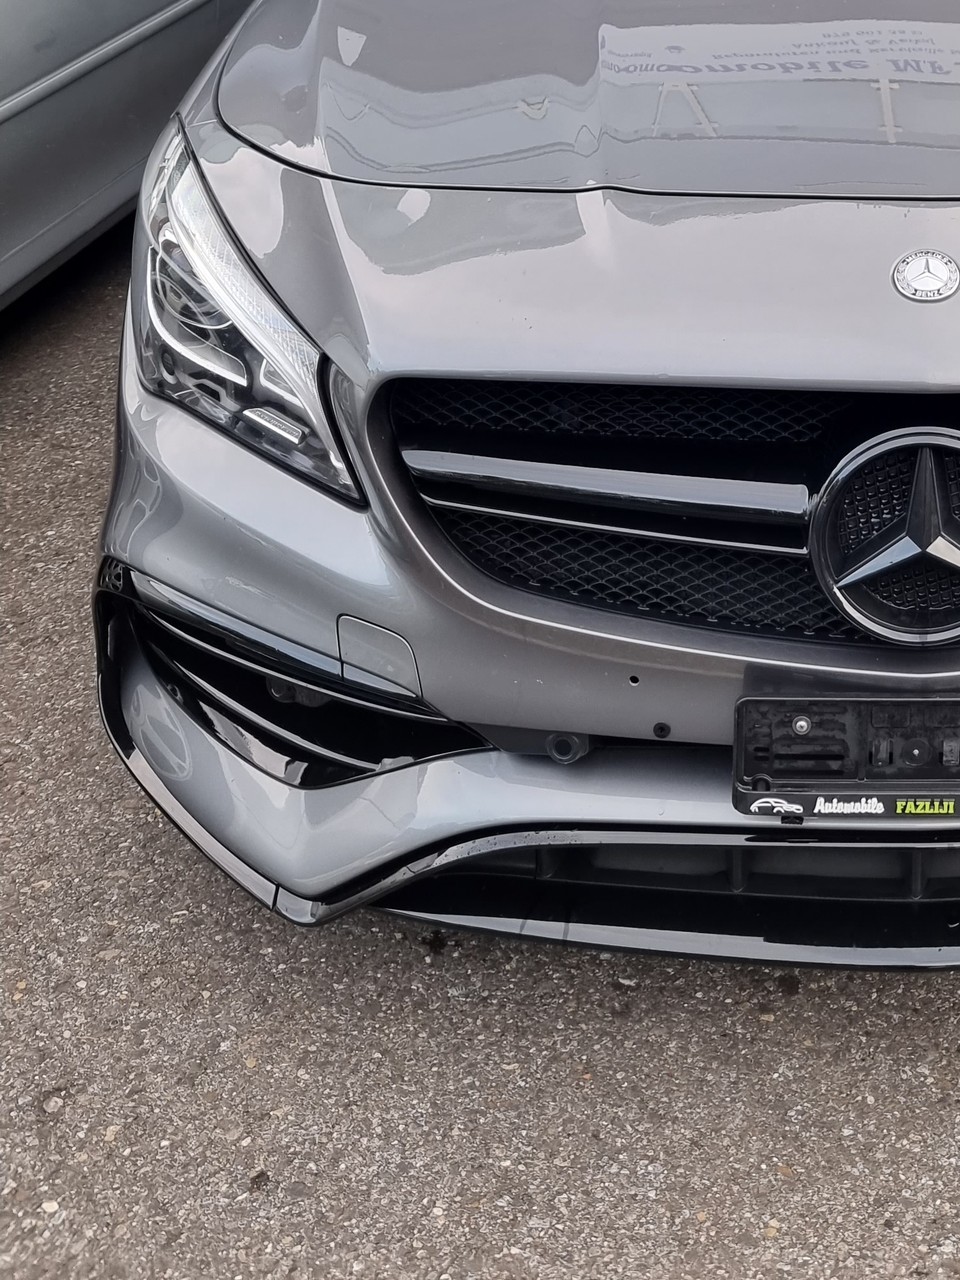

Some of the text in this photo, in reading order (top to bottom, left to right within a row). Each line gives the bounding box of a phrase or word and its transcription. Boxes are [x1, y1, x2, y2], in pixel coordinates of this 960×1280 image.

[905, 251, 950, 298] MERCEDES BENZ
[813, 797, 884, 814] Automobile
[896, 799, 955, 814] FAZLIJI
